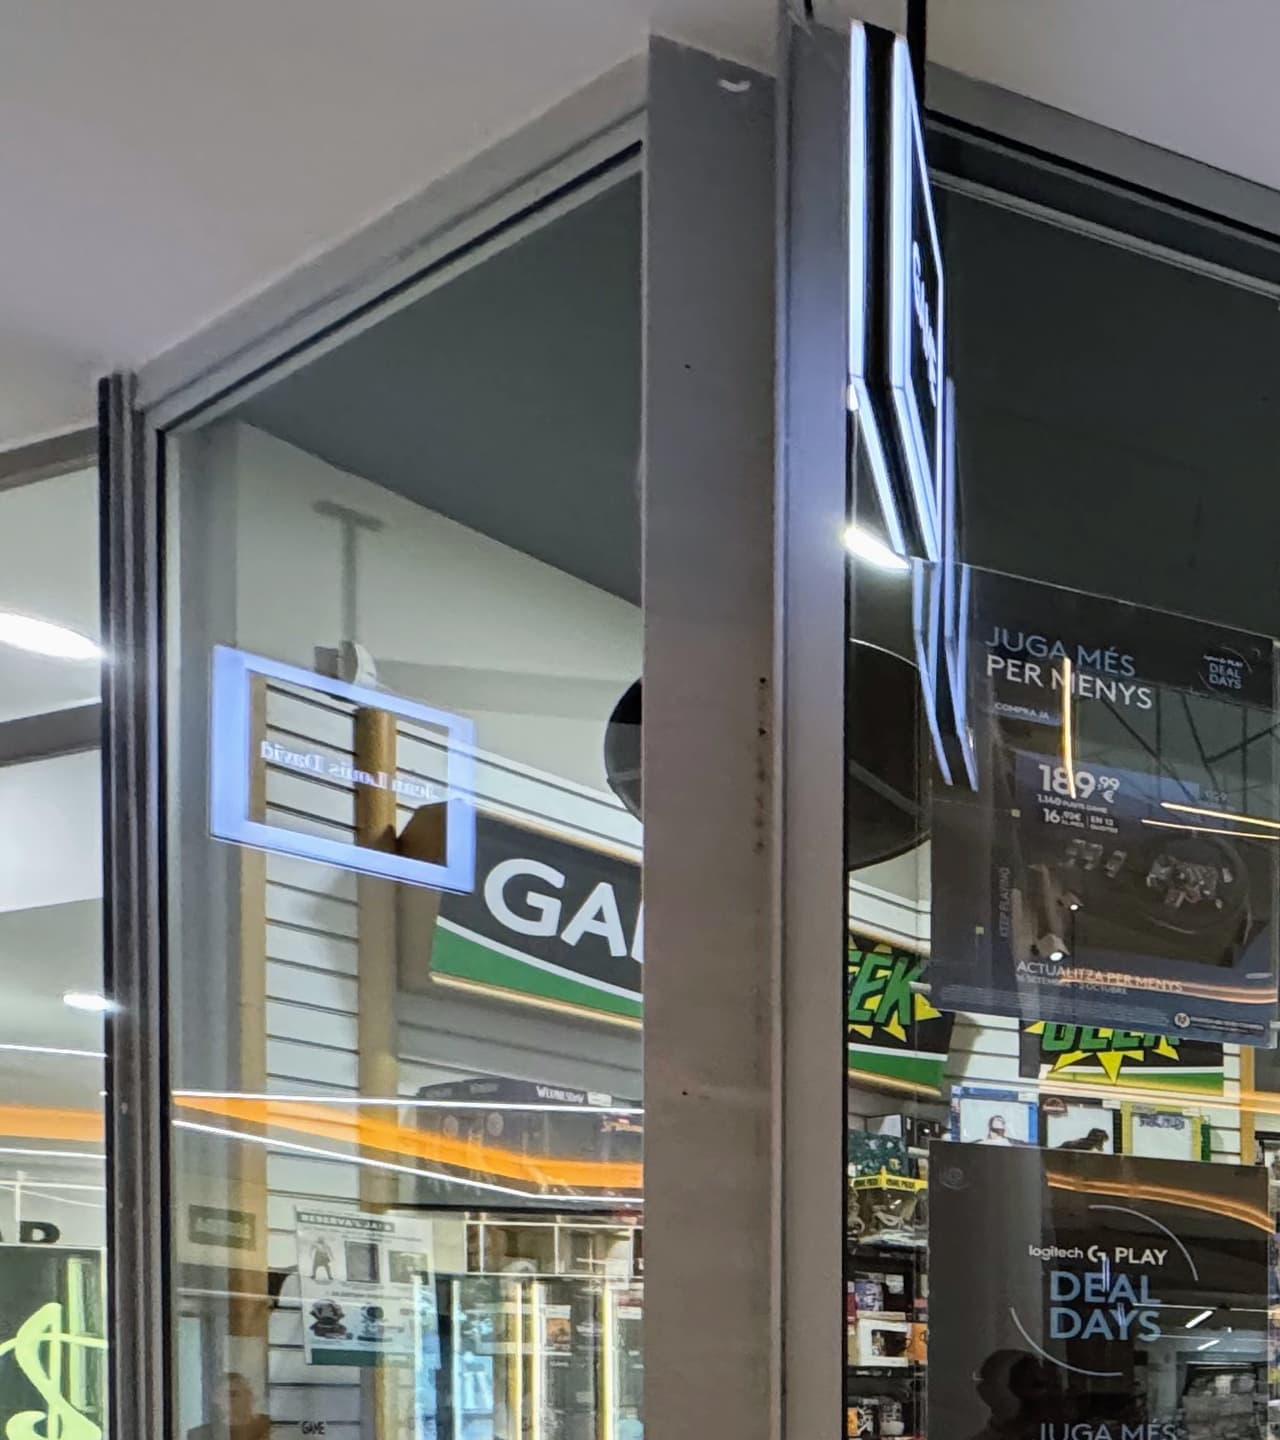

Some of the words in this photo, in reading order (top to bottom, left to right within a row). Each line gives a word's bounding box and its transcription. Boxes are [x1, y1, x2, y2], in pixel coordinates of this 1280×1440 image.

[985, 626, 1066, 657] JUGA
[1077, 643, 1136, 677] MÉS
[986, 654, 1043, 688] PER
[1051, 668, 1152, 709] MENYS
[1209, 662, 1240, 679] DEAL
[1209, 674, 1242, 690] DAYS
[483, 857, 644, 963] GA
[1017, 959, 1105, 983] ACTUALITZA
[1028, 1244, 1083, 1260] logitech
[1115, 1248, 1168, 1266] PLAY
[1050, 1270, 1161, 1305] DEAL
[1050, 1307, 1162, 1342] DAYS
